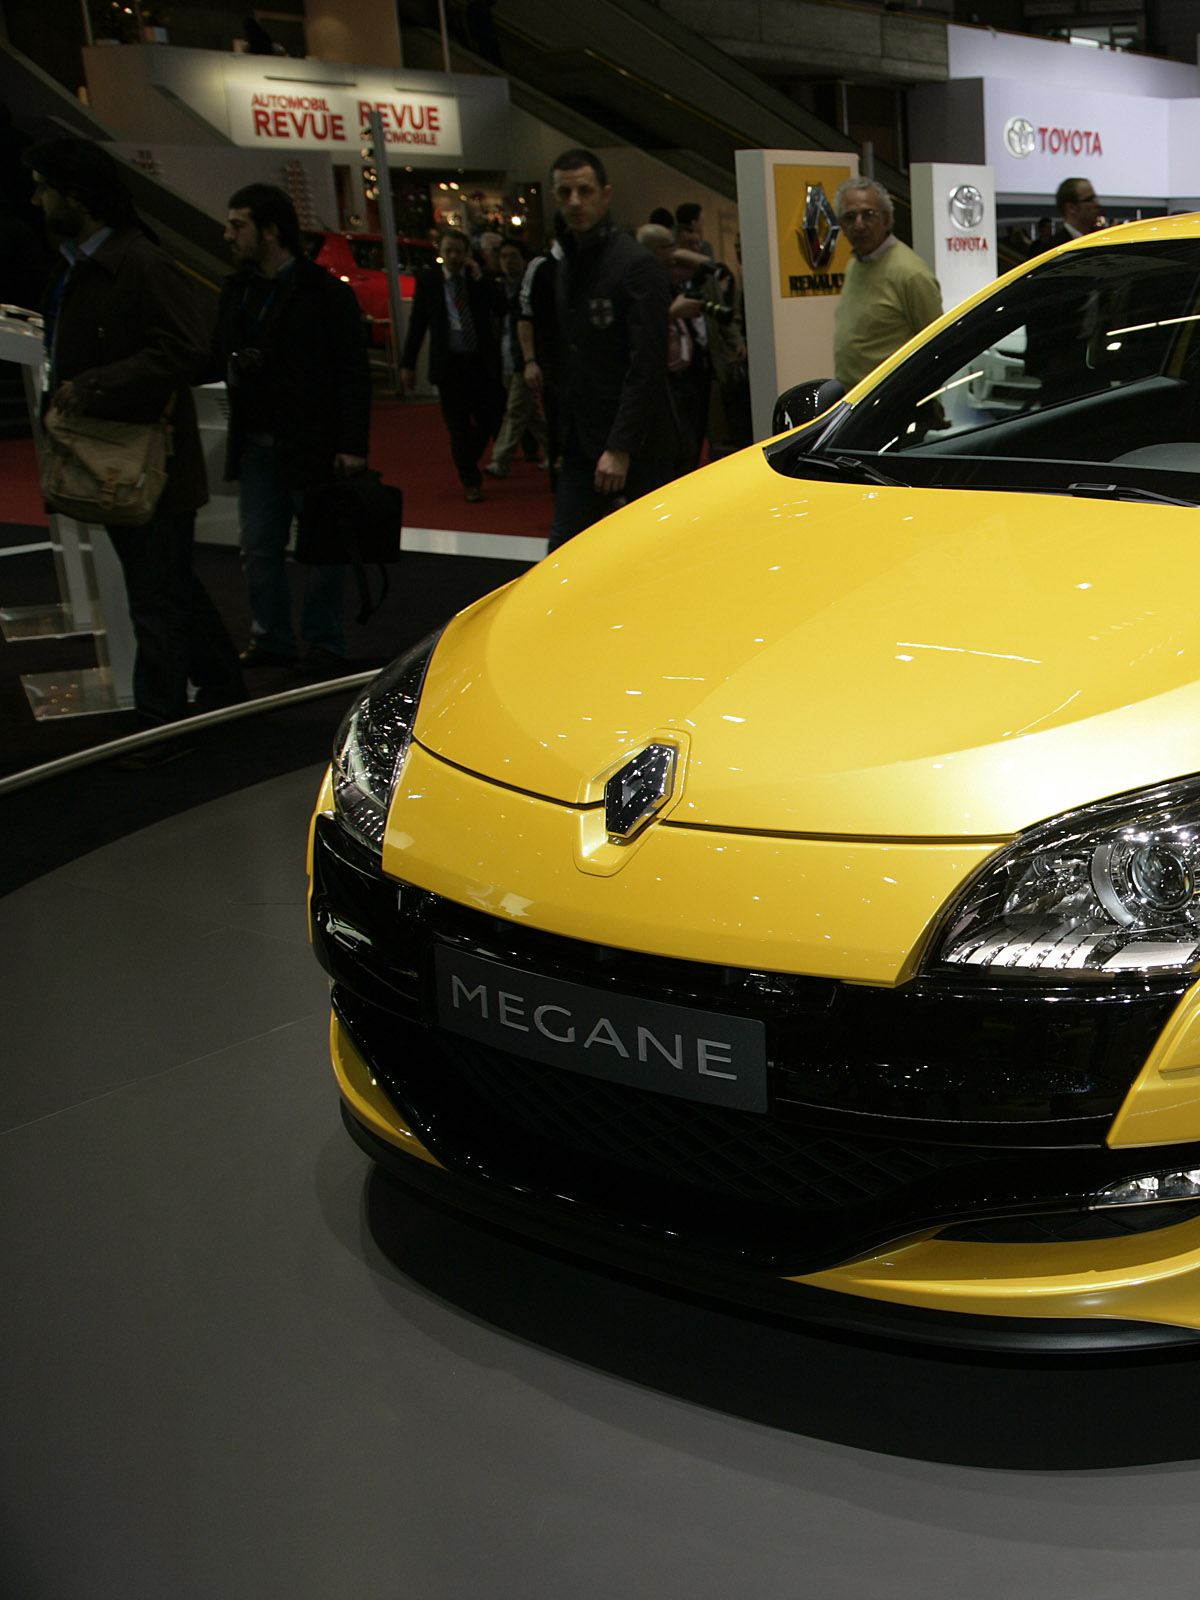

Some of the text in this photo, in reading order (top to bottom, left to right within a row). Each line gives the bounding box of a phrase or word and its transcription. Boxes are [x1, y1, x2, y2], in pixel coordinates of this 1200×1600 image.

[251, 93, 330, 112] AUTOMOBIL
[357, 101, 441, 131] REVUE
[253, 110, 346, 141] REVUE
[366, 128, 437, 146] OMOBILE
[1038, 127, 1102, 156] TOYOTA
[946, 237, 989, 252] TOYOTA
[451, 974, 738, 1081] MEGANE
